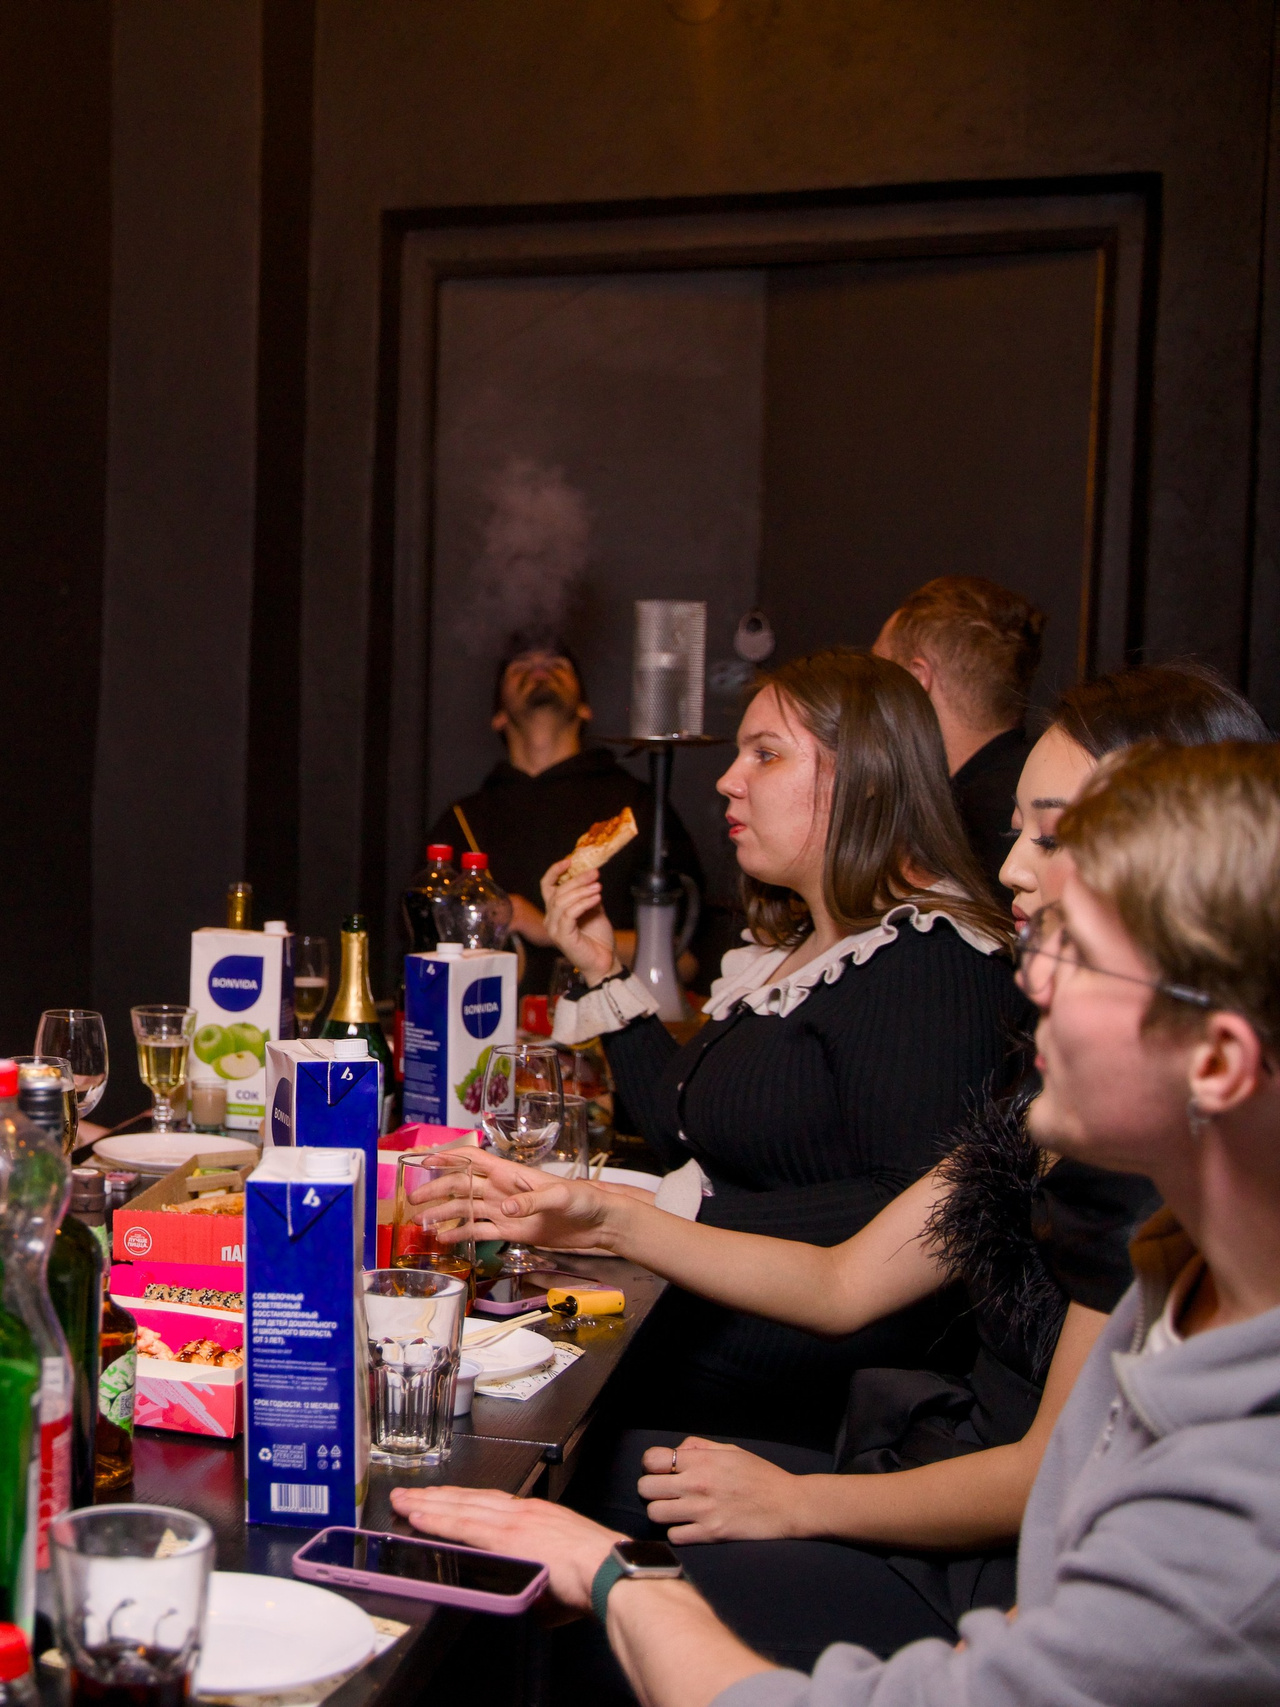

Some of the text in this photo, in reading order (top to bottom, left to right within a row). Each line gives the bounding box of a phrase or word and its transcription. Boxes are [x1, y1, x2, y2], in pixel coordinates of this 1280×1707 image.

[212, 977, 258, 990] BONVIDA
[464, 1001, 499, 1015] BONVIDA
[236, 1090, 259, 1100] СОК
[274, 1107, 291, 1127] BONVID
[252, 1292, 304, 1301] СОК ЯБЛОЧНЫЙ
[252, 1310, 318, 1319] ВОССТАНОВЛЕННЫЙ
[252, 1319, 337, 1329] ДЛЯ ДЕТЕЙ ДОШКОЛЬНОГО
[259, 1328, 298, 1336] ШКОЛЬНОГО
[299, 1329, 332, 1338] ВОЗРАСТА
[253, 1336, 263, 1344] (ОТ
[253, 1398, 269, 1406] СРОК
[270, 1400, 302, 1408] ГОДНОСТИ:
